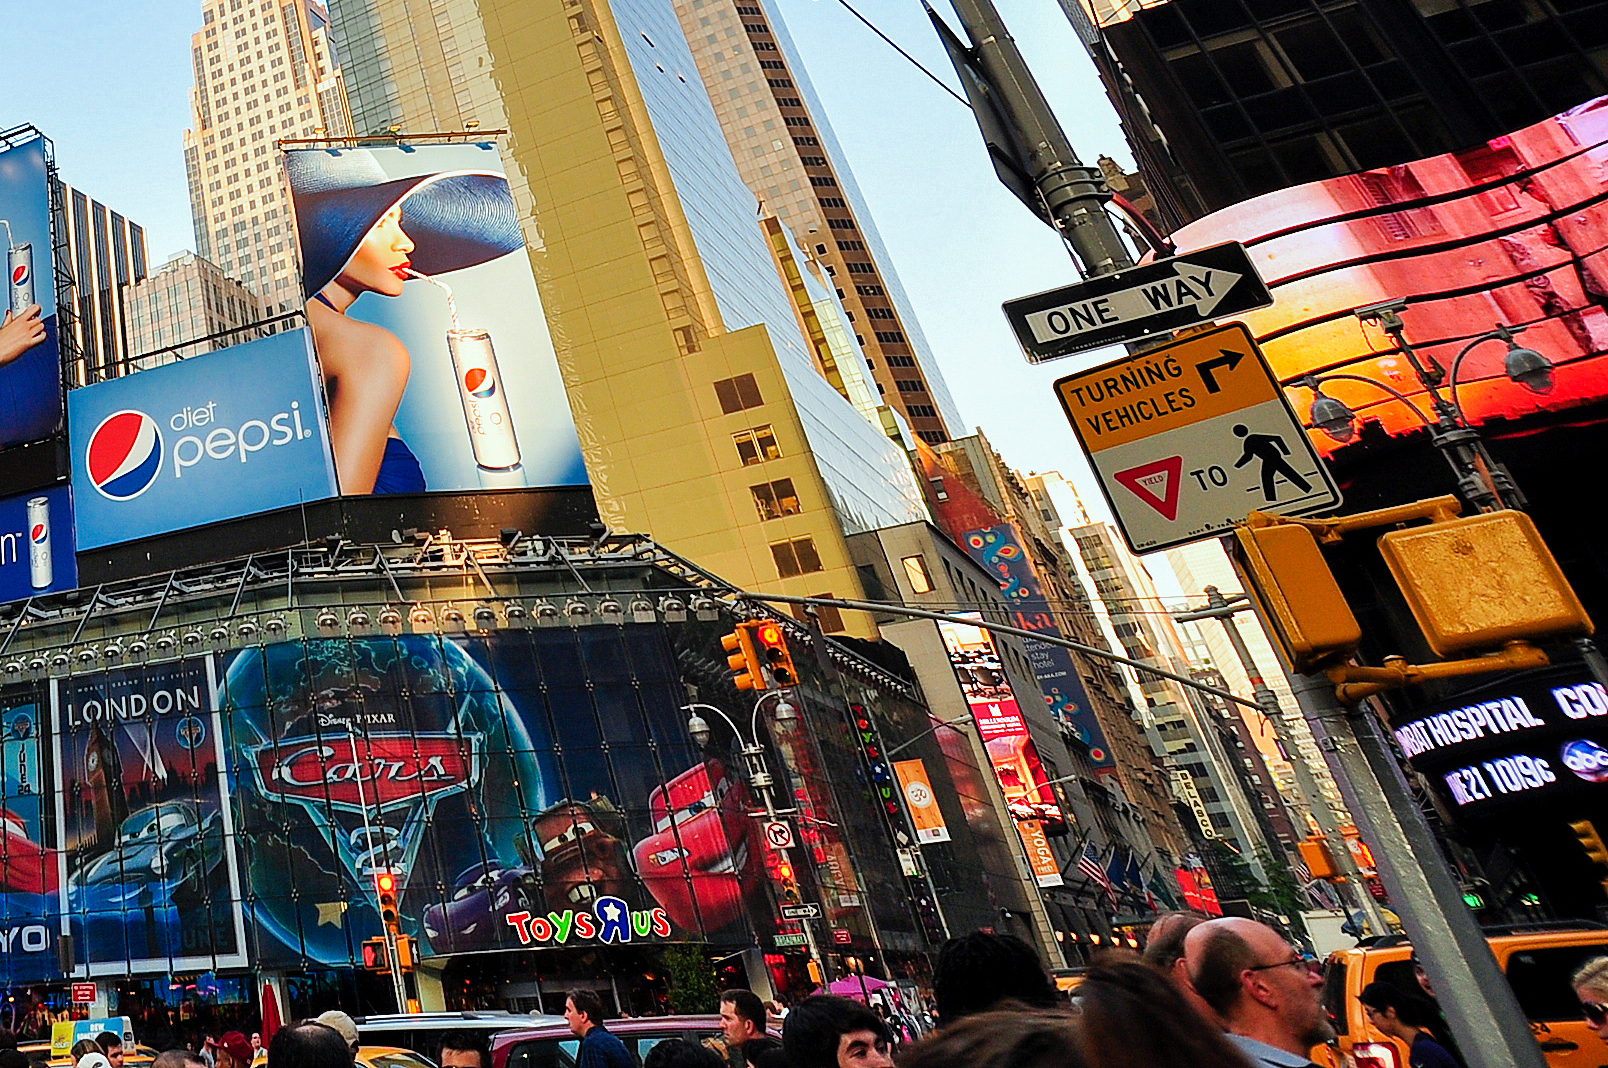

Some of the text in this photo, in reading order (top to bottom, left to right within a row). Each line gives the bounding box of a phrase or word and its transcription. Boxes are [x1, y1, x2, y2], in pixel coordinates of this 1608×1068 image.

[1046, 269, 1218, 337] ONE WAY
[1070, 356, 1183, 408] TURNING
[169, 401, 218, 432] diet
[1085, 387, 1197, 436] VEHICLES
[172, 401, 307, 479] pepsi
[1142, 465, 1229, 492] YIELD TO
[1031, 652, 1049, 661] stay
[1033, 659, 1055, 669] hotel
[67, 685, 200, 727] LONDON
[356, 713, 397, 725] PIXAR
[1424, 695, 1547, 747] HOSPITAL
[271, 746, 457, 787] Cars
[17, 784, 32, 795] 24
[1179, 772, 1213, 838] BELASCO
[1029, 829, 1053, 866] YOGA
